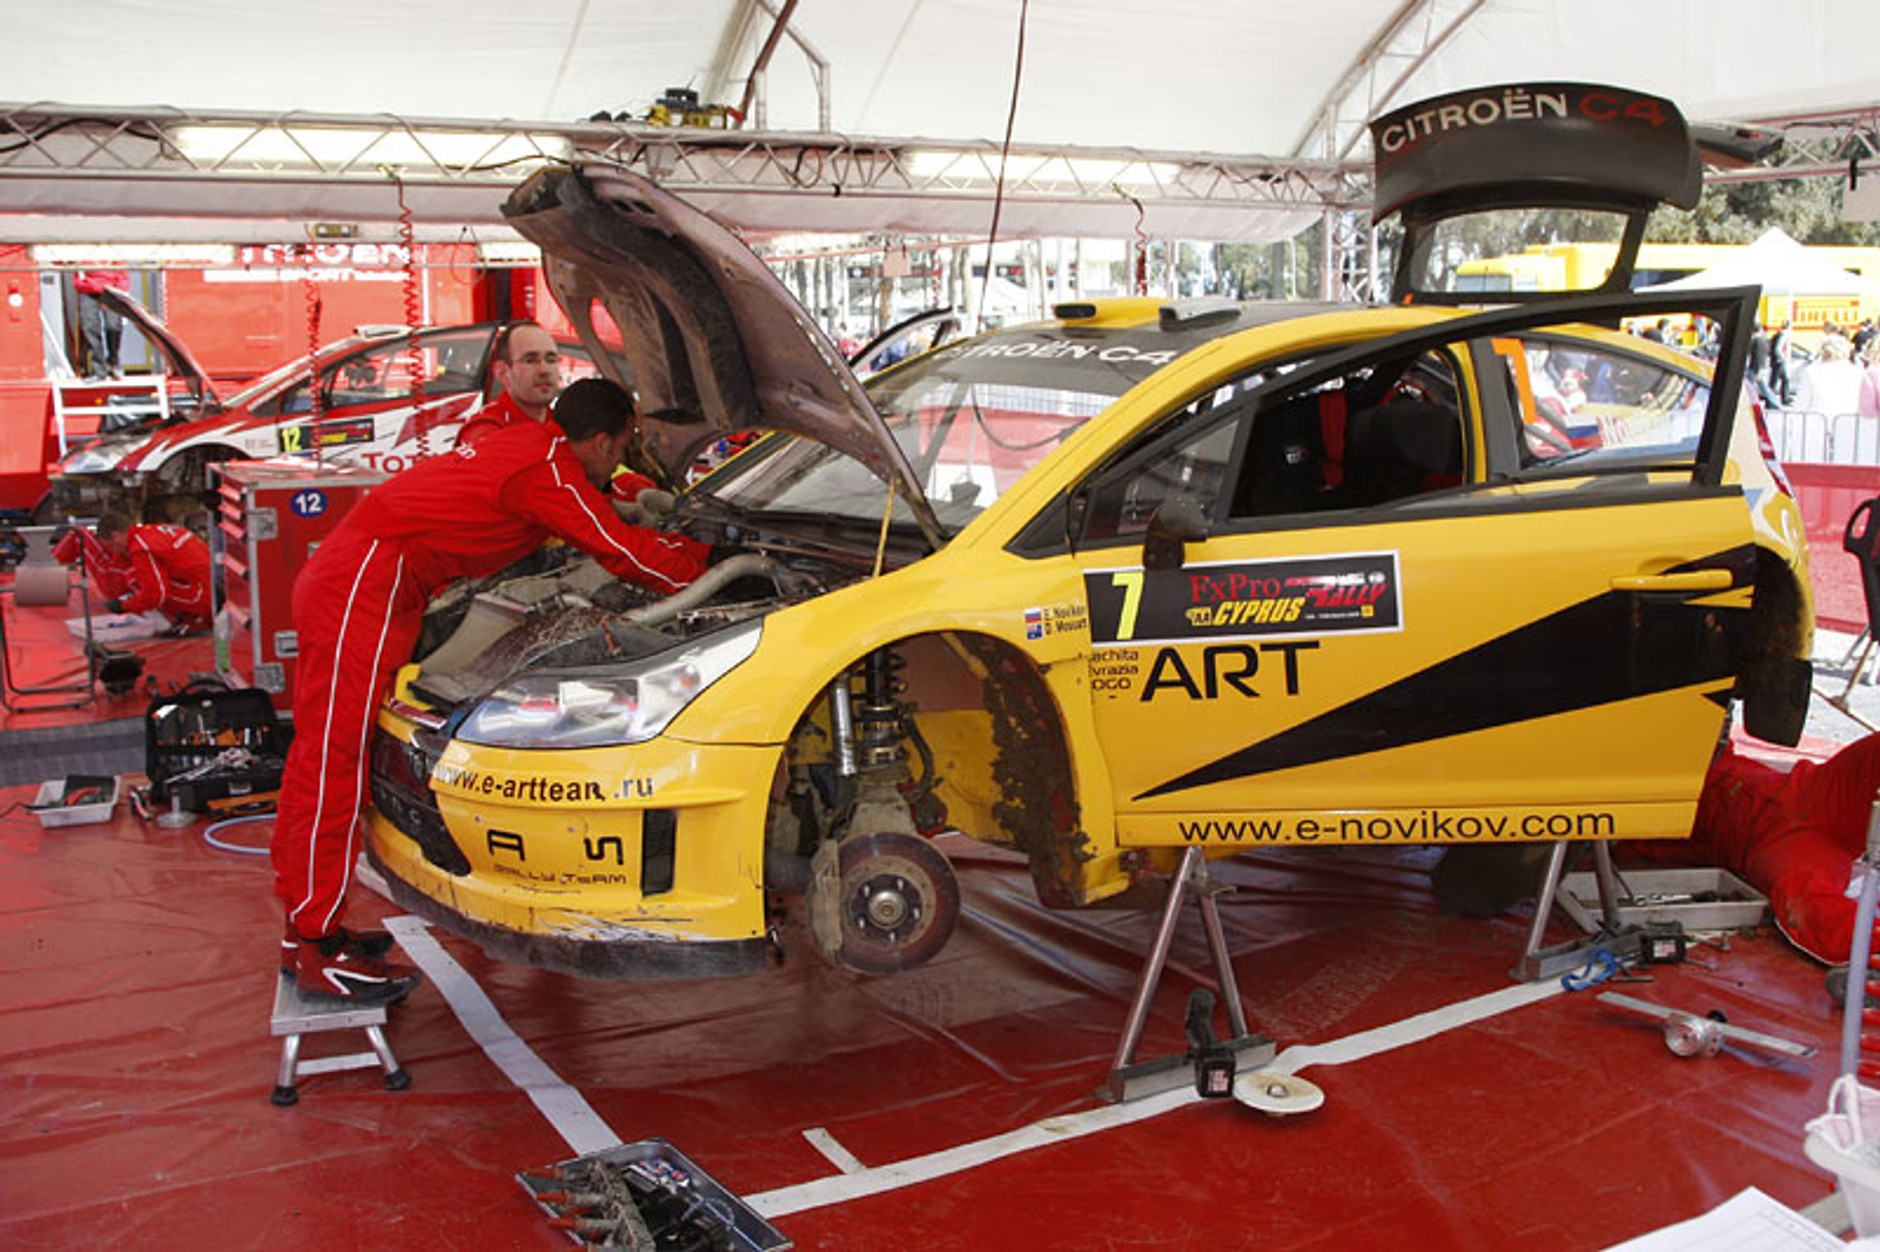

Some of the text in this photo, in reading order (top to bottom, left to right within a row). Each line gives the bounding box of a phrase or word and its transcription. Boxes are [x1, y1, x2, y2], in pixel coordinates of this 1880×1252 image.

[1381, 88, 1667, 152] CITROËN C4
[1099, 346, 1180, 366] C4
[282, 427, 303, 453] 12
[361, 451, 421, 474] TOT
[296, 492, 322, 514] 12
[1189, 572, 1282, 603] FxPro
[1304, 582, 1388, 608] RALLY
[1111, 570, 1145, 641] 7
[1212, 596, 1307, 627] CYPRUS
[1140, 641, 1320, 702] ART
[1178, 810, 1615, 842] www.e-novikov.com
